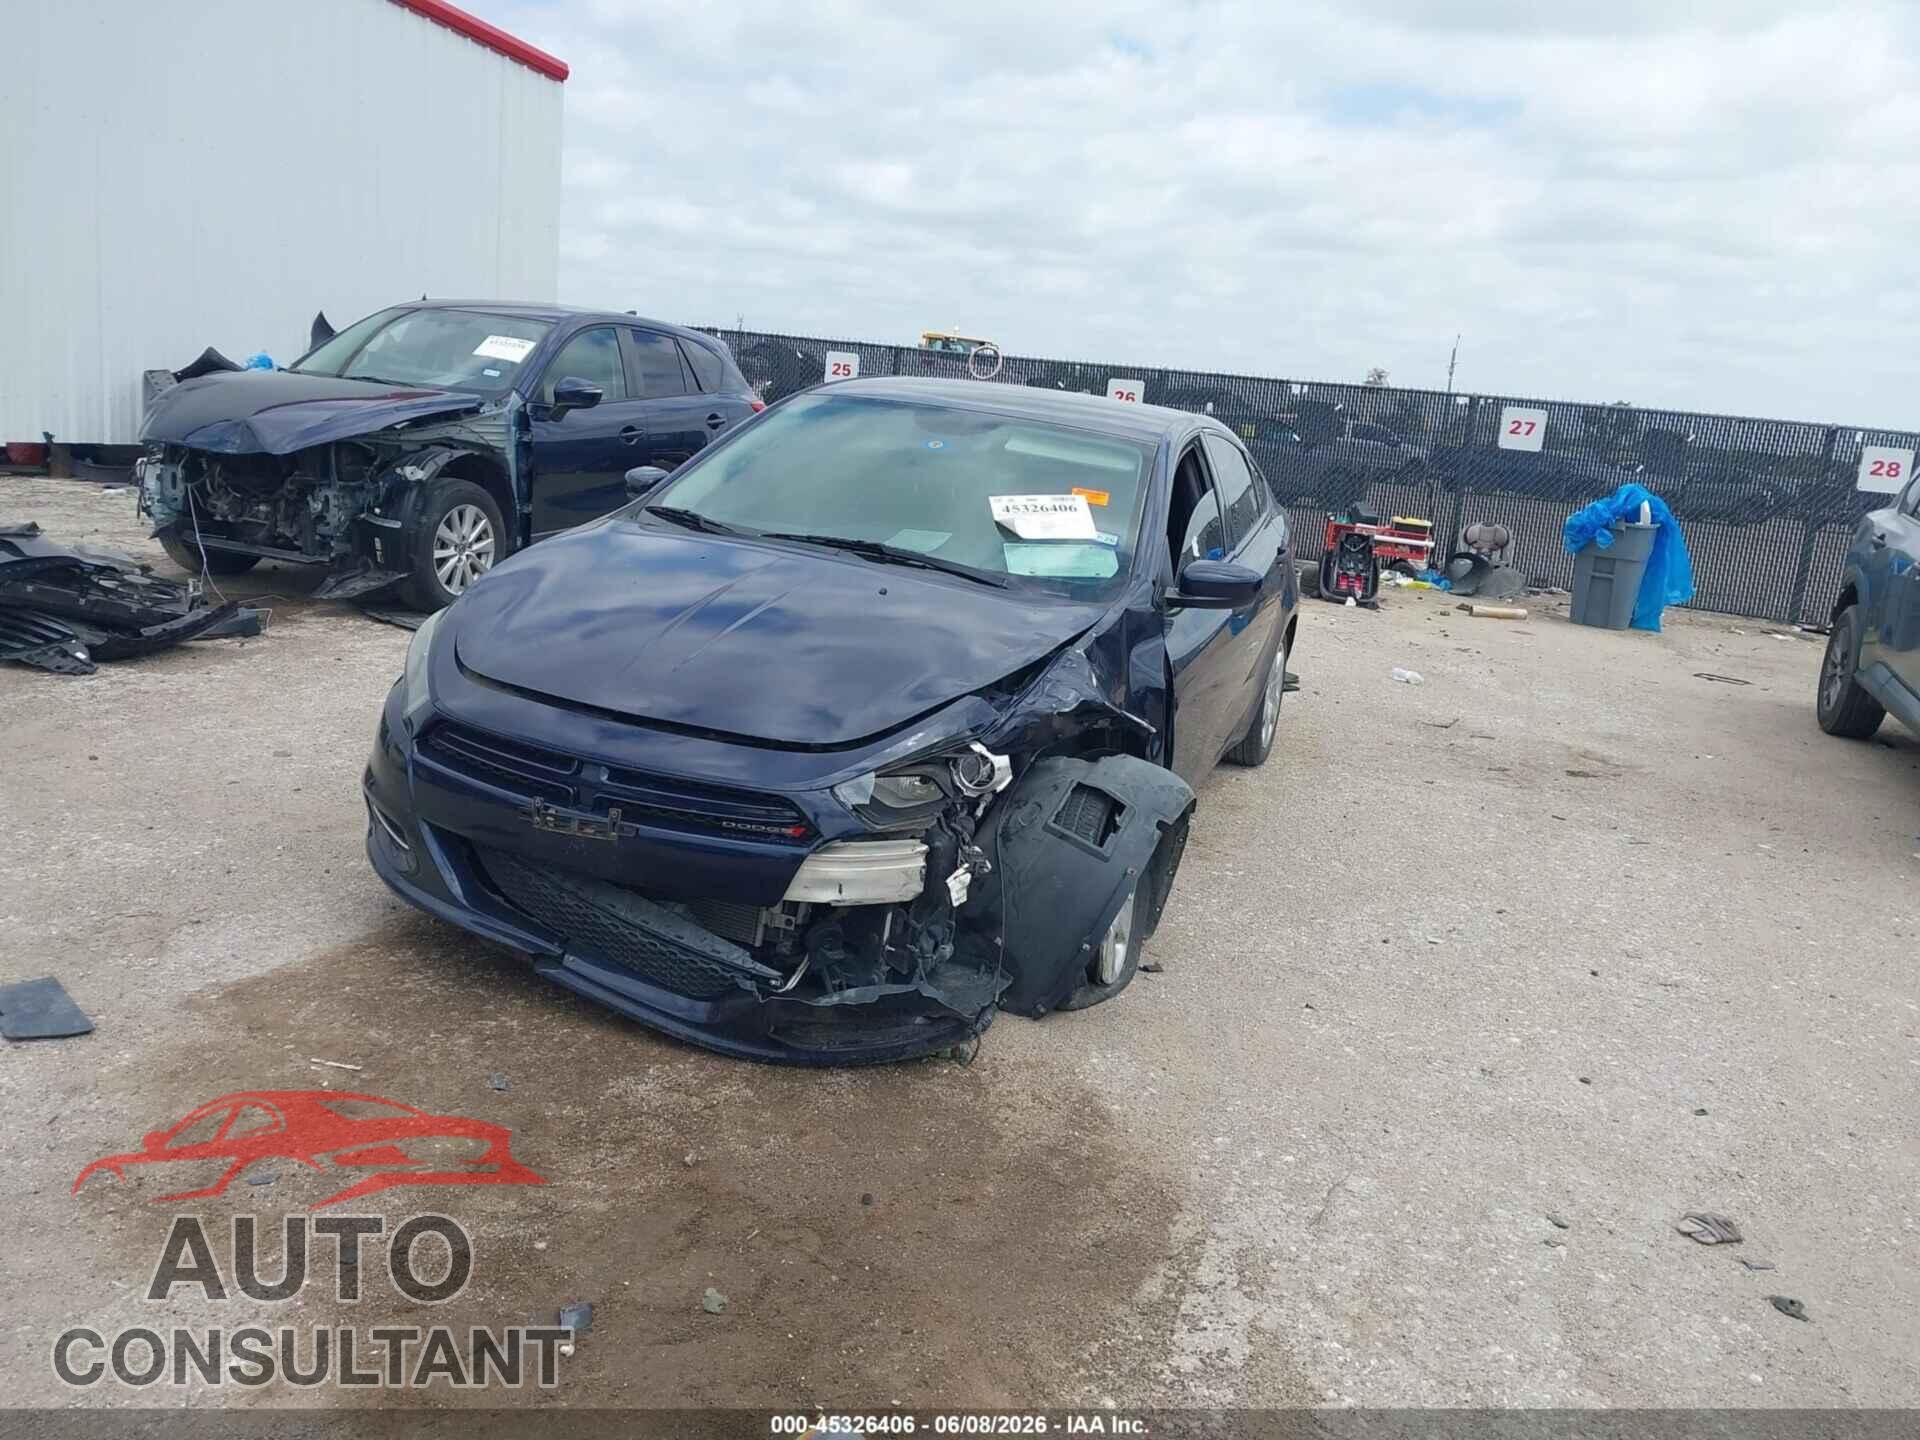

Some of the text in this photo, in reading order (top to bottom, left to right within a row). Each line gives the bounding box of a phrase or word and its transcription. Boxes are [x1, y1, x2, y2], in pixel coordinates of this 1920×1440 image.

[831, 362, 852, 377] 25
[1115, 390, 1136, 402] 26
[1509, 420, 1536, 436] 27
[1869, 460, 1901, 478] 28
[1002, 503, 1078, 514] 45326406
